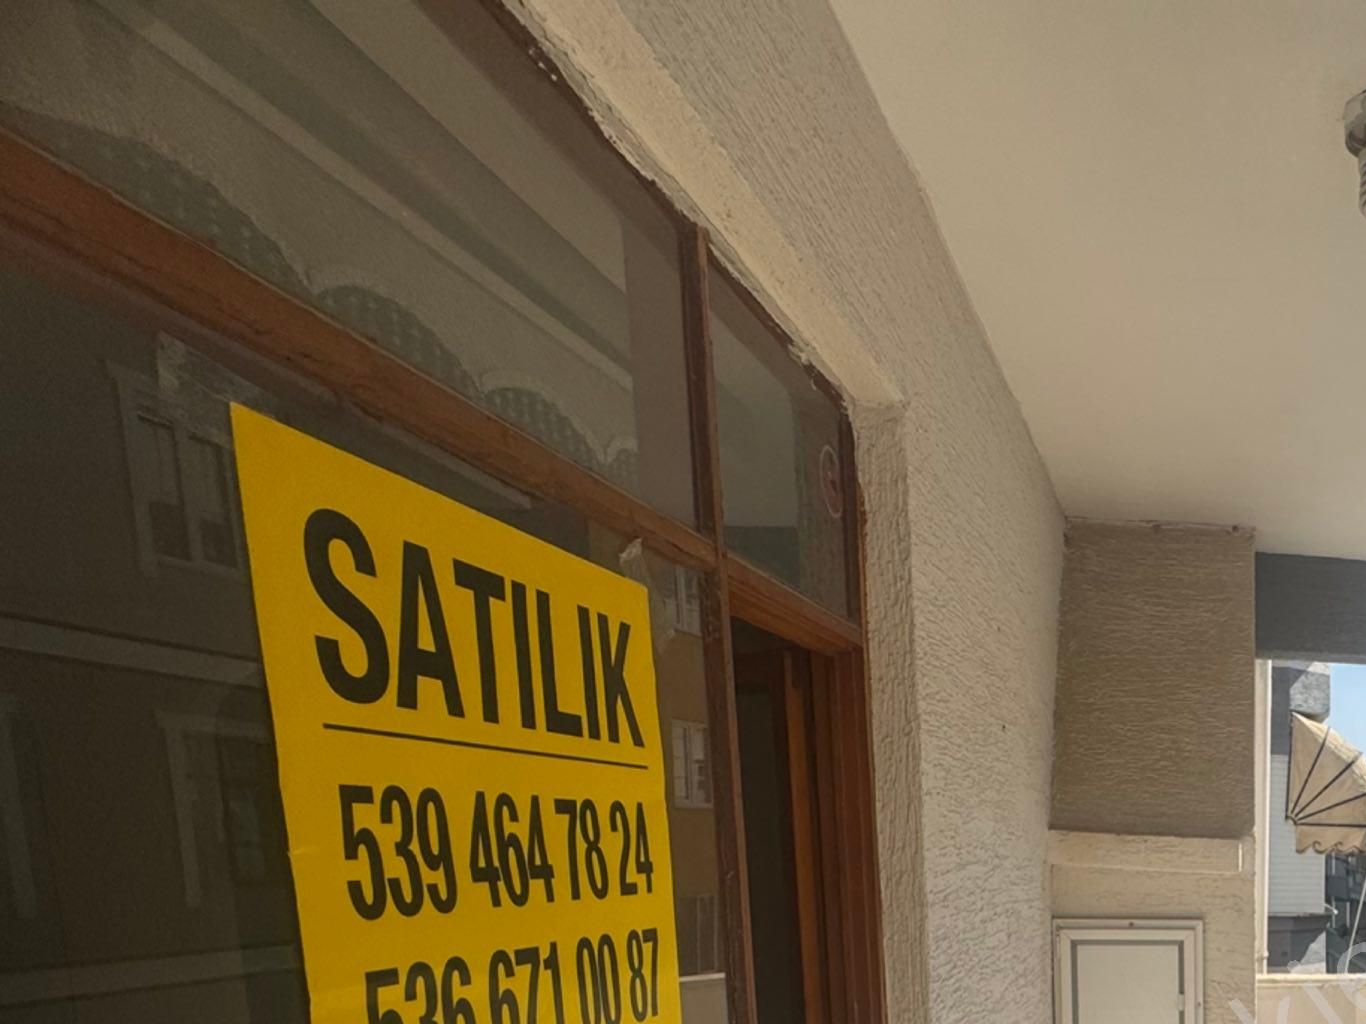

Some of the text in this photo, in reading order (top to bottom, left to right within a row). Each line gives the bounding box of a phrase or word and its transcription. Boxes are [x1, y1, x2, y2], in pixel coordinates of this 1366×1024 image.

[303, 507, 645, 748] SATILIK
[338, 784, 654, 921] 539 464 78 24
[626, 927, 660, 1023] 87
